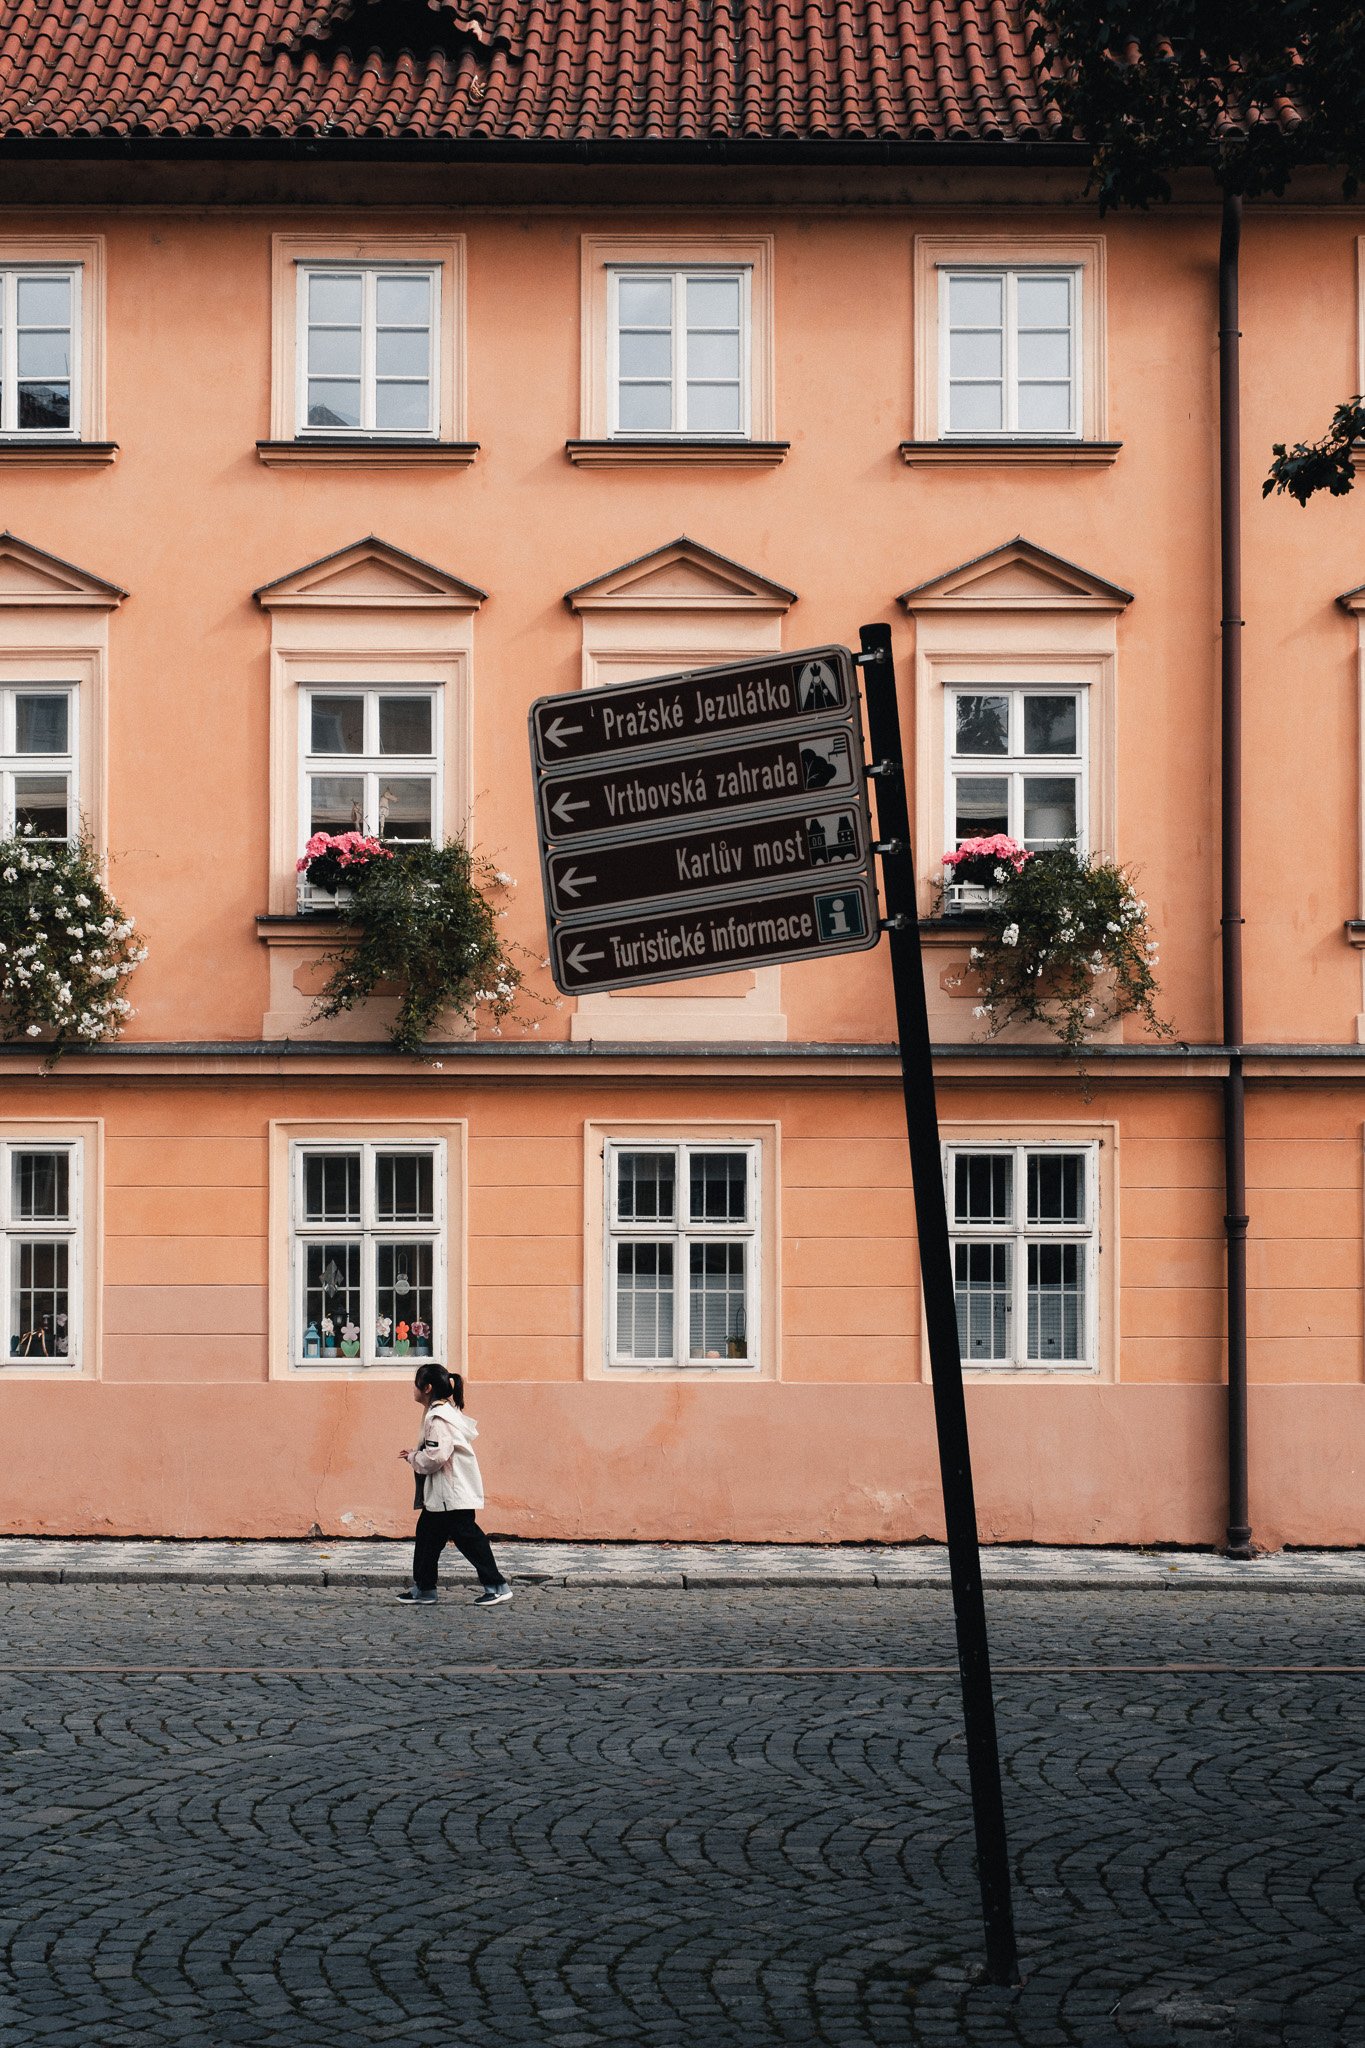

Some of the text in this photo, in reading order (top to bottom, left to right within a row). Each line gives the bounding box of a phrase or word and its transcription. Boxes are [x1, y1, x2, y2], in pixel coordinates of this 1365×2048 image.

[603, 679, 791, 740] Pražské Jezulátko
[604, 755, 798, 816] Vrtbovská zahrada
[676, 831, 805, 880] Karlův most
[610, 923, 706, 968] Turistické
[710, 914, 813, 951] informace
